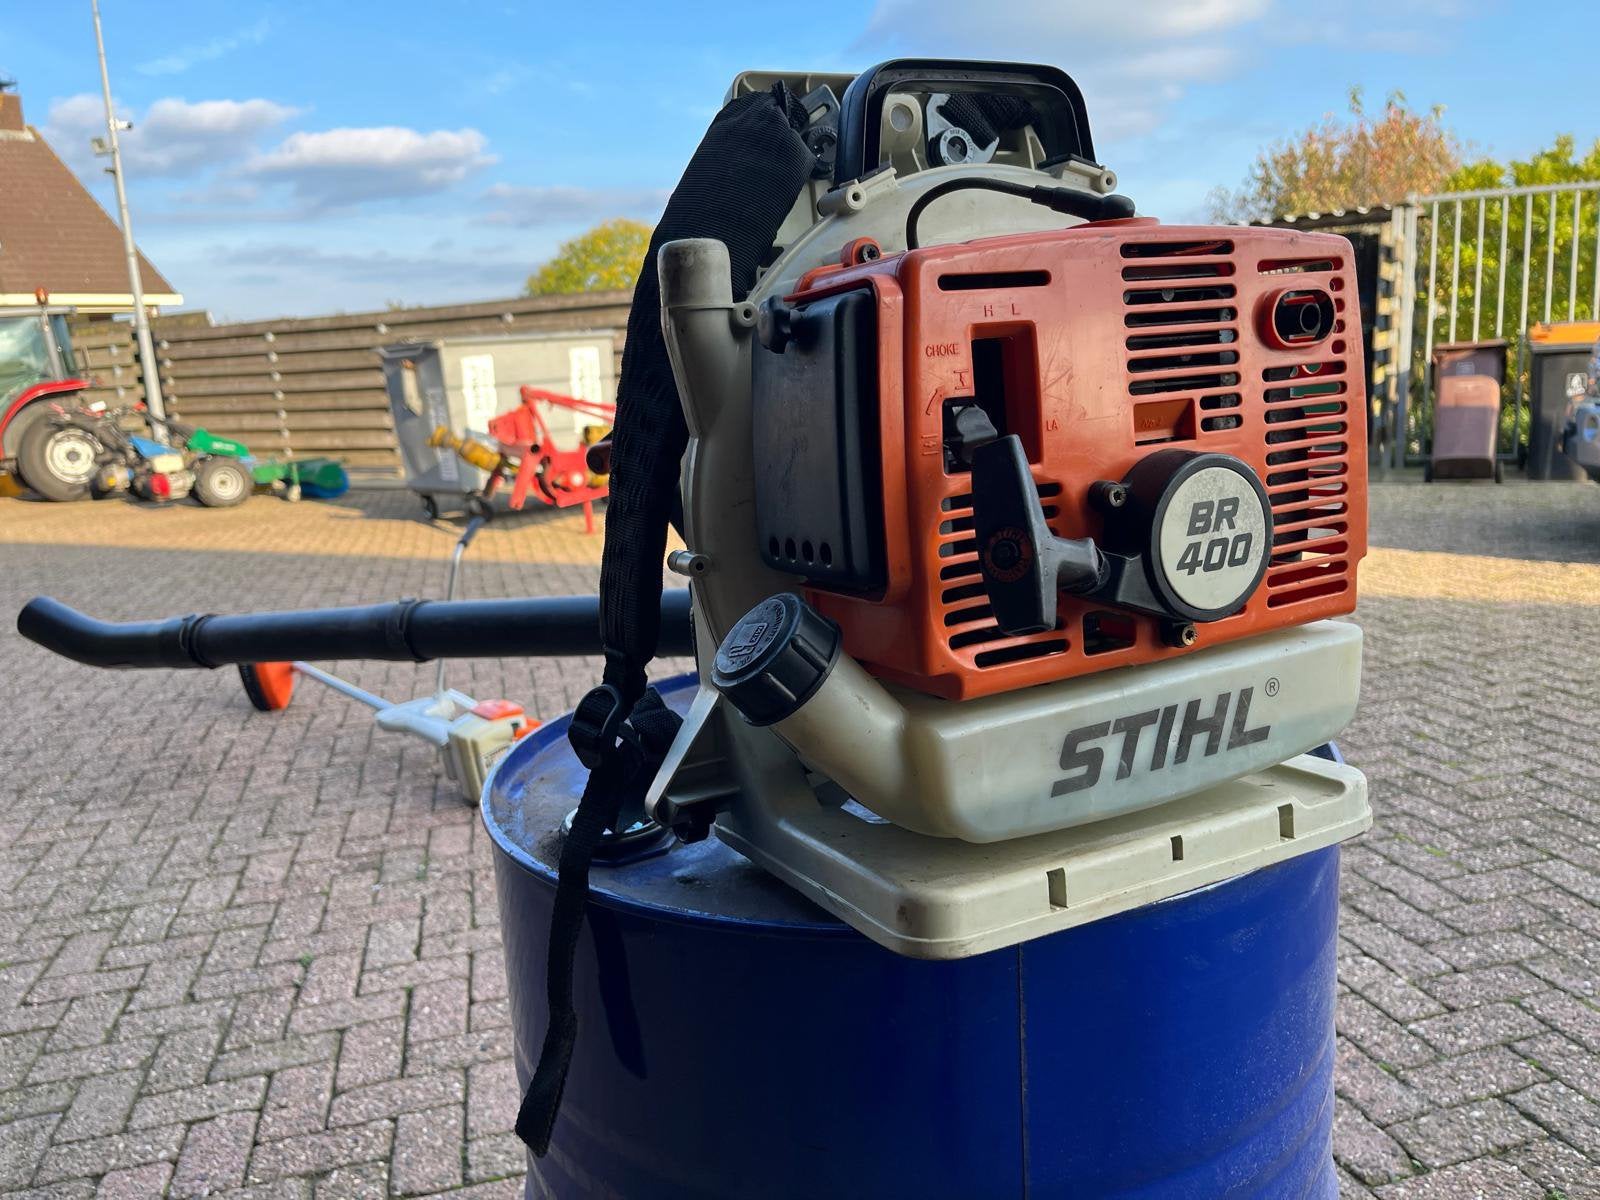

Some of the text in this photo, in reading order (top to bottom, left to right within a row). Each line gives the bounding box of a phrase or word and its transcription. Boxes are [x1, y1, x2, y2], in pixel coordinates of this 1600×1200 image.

[983, 303, 1021, 318] H L
[925, 343, 960, 358] CHOKE
[1186, 496, 1240, 537] BR
[1176, 532, 1253, 576] 400
[1050, 686, 1271, 798] STIHL
